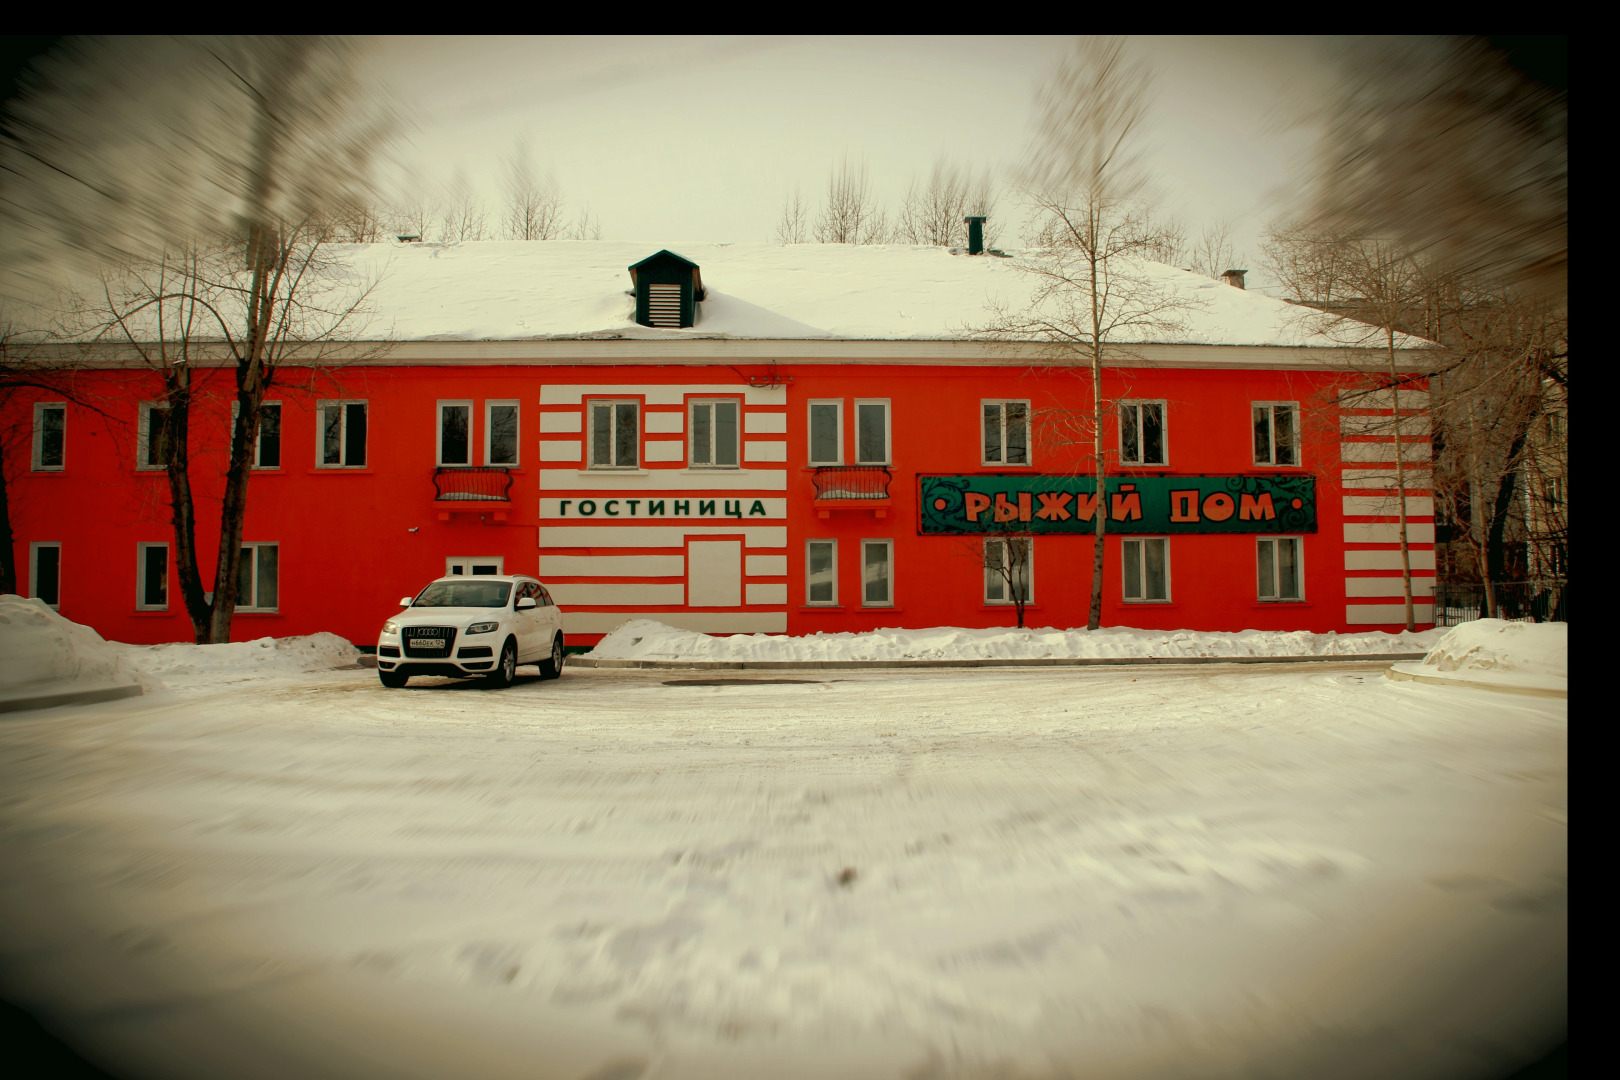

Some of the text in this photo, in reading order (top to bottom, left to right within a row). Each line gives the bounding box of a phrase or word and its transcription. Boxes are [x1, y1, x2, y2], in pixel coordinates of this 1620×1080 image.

[560, 500, 767, 519] ГОСТИНИЦА
[963, 484, 1276, 523] РЫЖИЙ ДОМ
